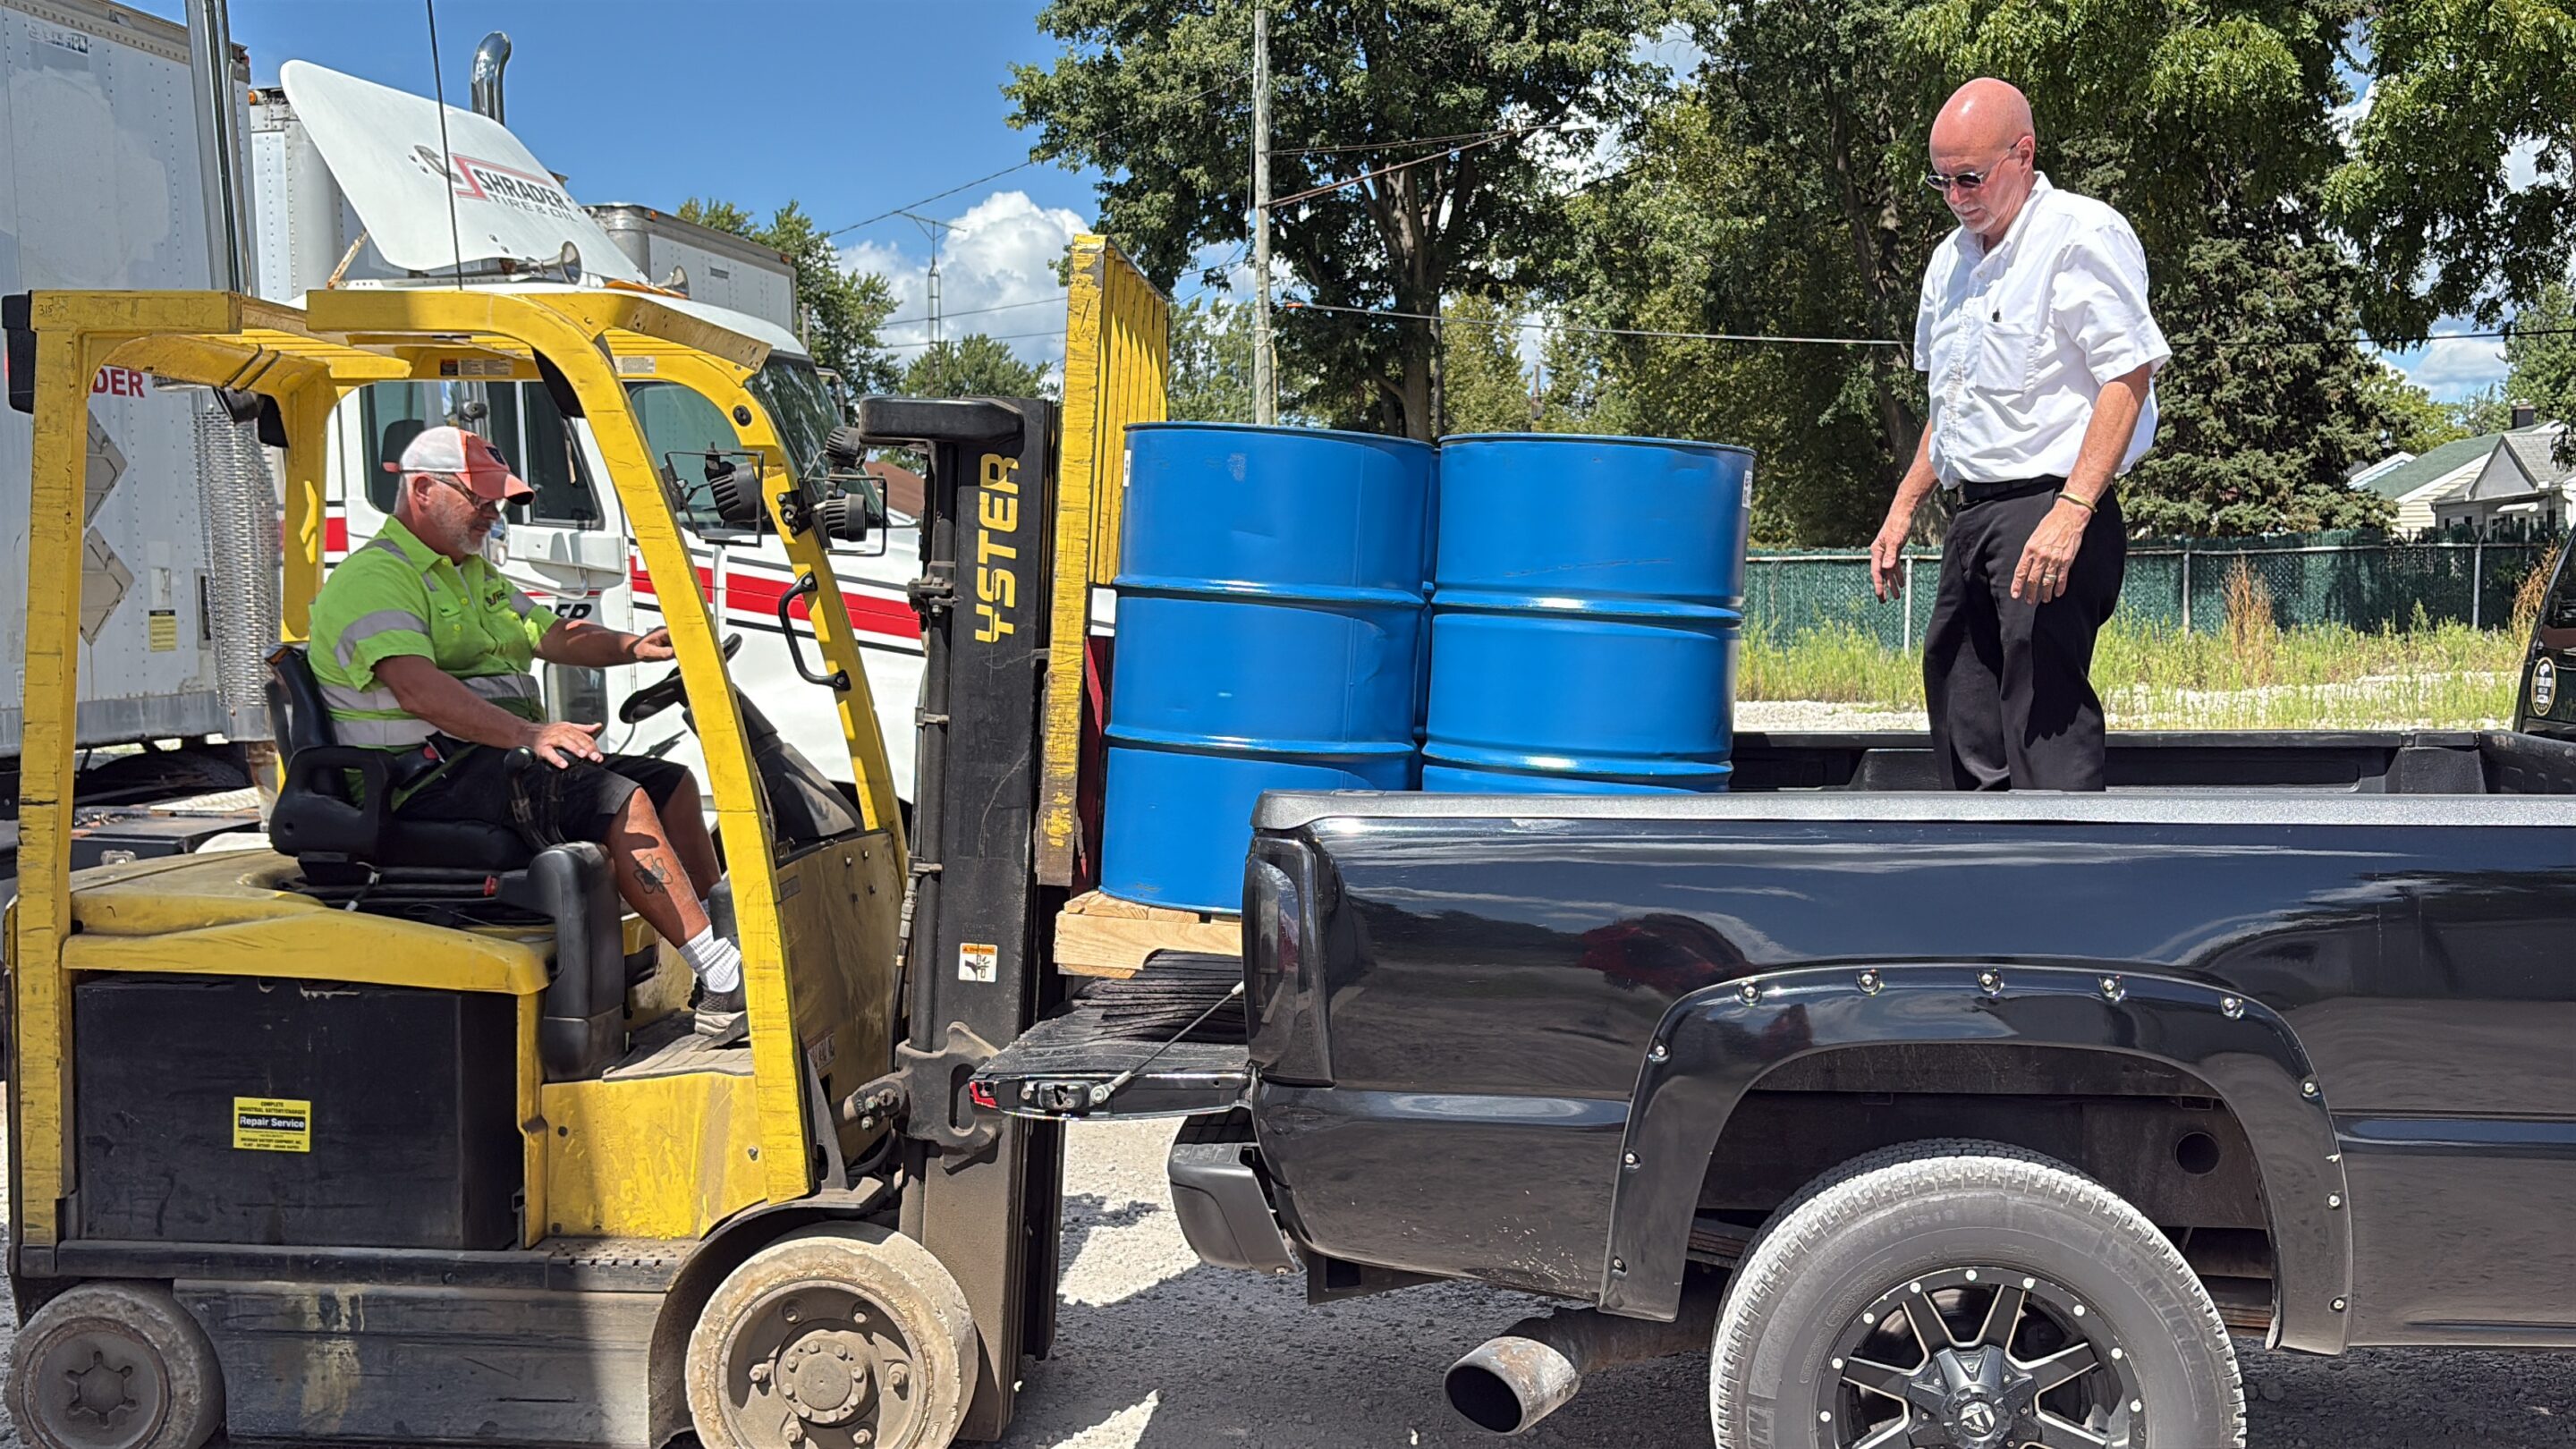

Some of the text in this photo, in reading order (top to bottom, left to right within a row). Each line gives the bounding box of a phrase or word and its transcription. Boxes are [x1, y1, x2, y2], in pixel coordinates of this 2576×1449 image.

[472, 168, 570, 211] SHRADER
[488, 192, 531, 211] TIRE
[549, 208, 580, 223] OIL
[240, 1116, 305, 1128] Repair Service
